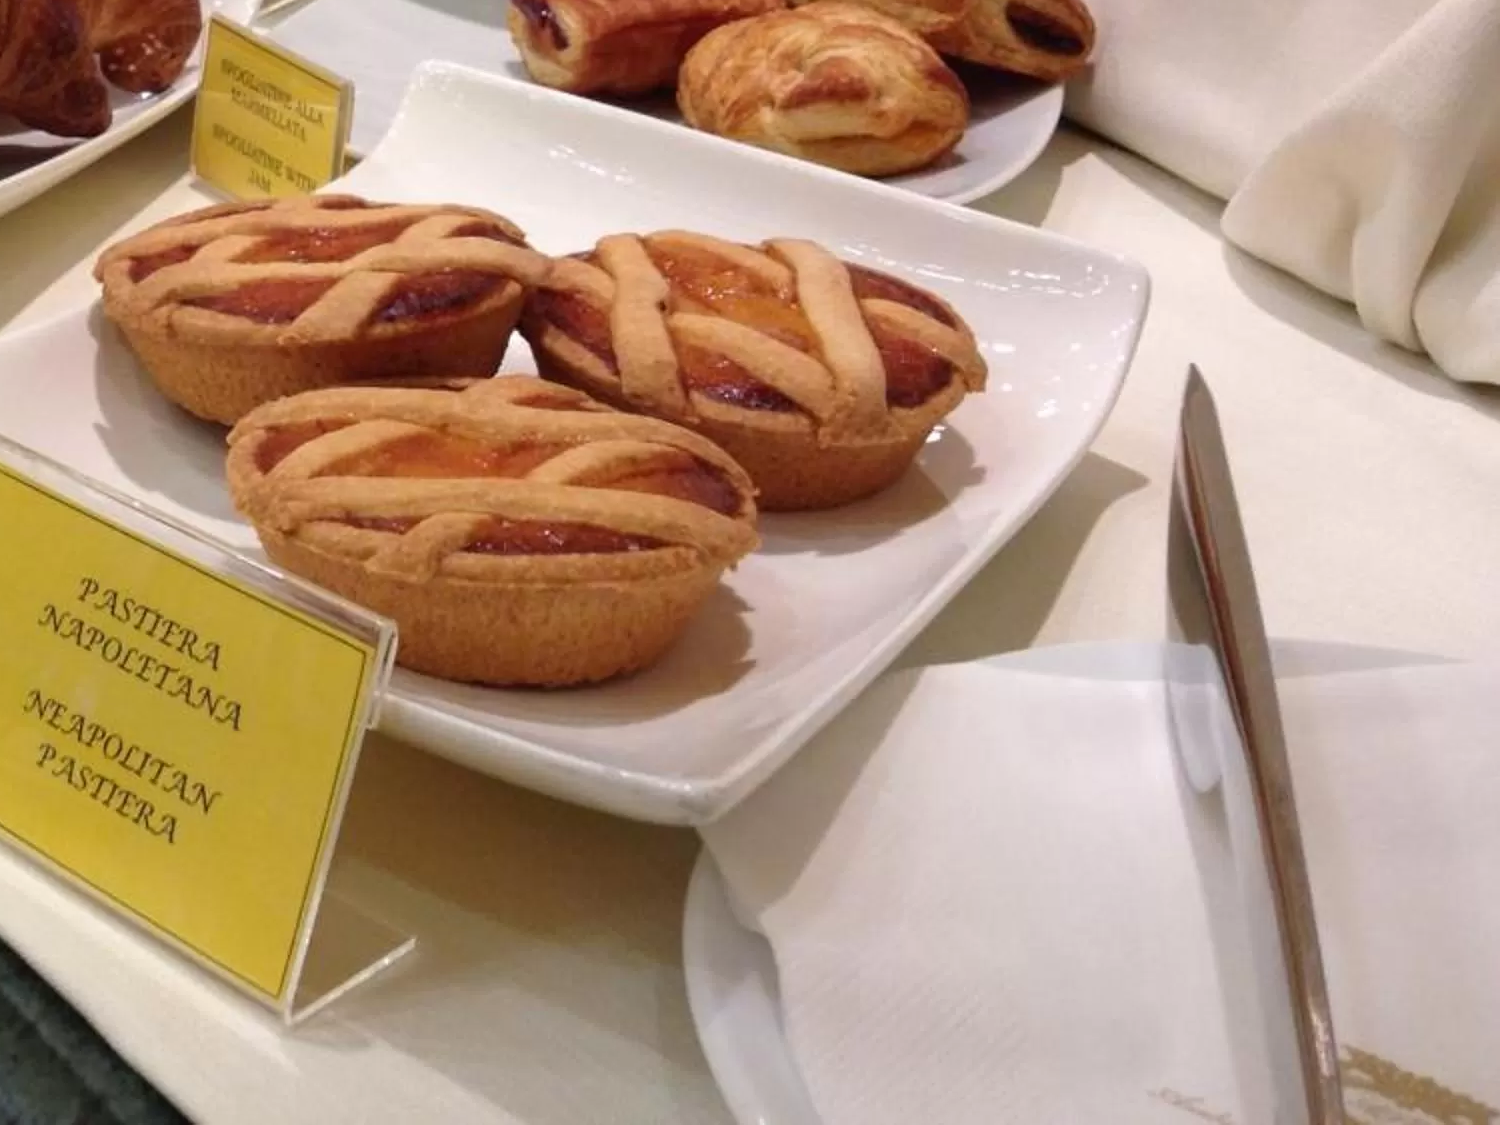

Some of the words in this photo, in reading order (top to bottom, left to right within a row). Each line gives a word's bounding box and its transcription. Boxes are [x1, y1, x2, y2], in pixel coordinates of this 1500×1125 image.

[38, 605, 243, 731] NAPOLETANA
[79, 577, 222, 671] PASTIERA
[23, 690, 222, 814] NEAPOLITAN
[35, 743, 176, 845] PASTIERA
